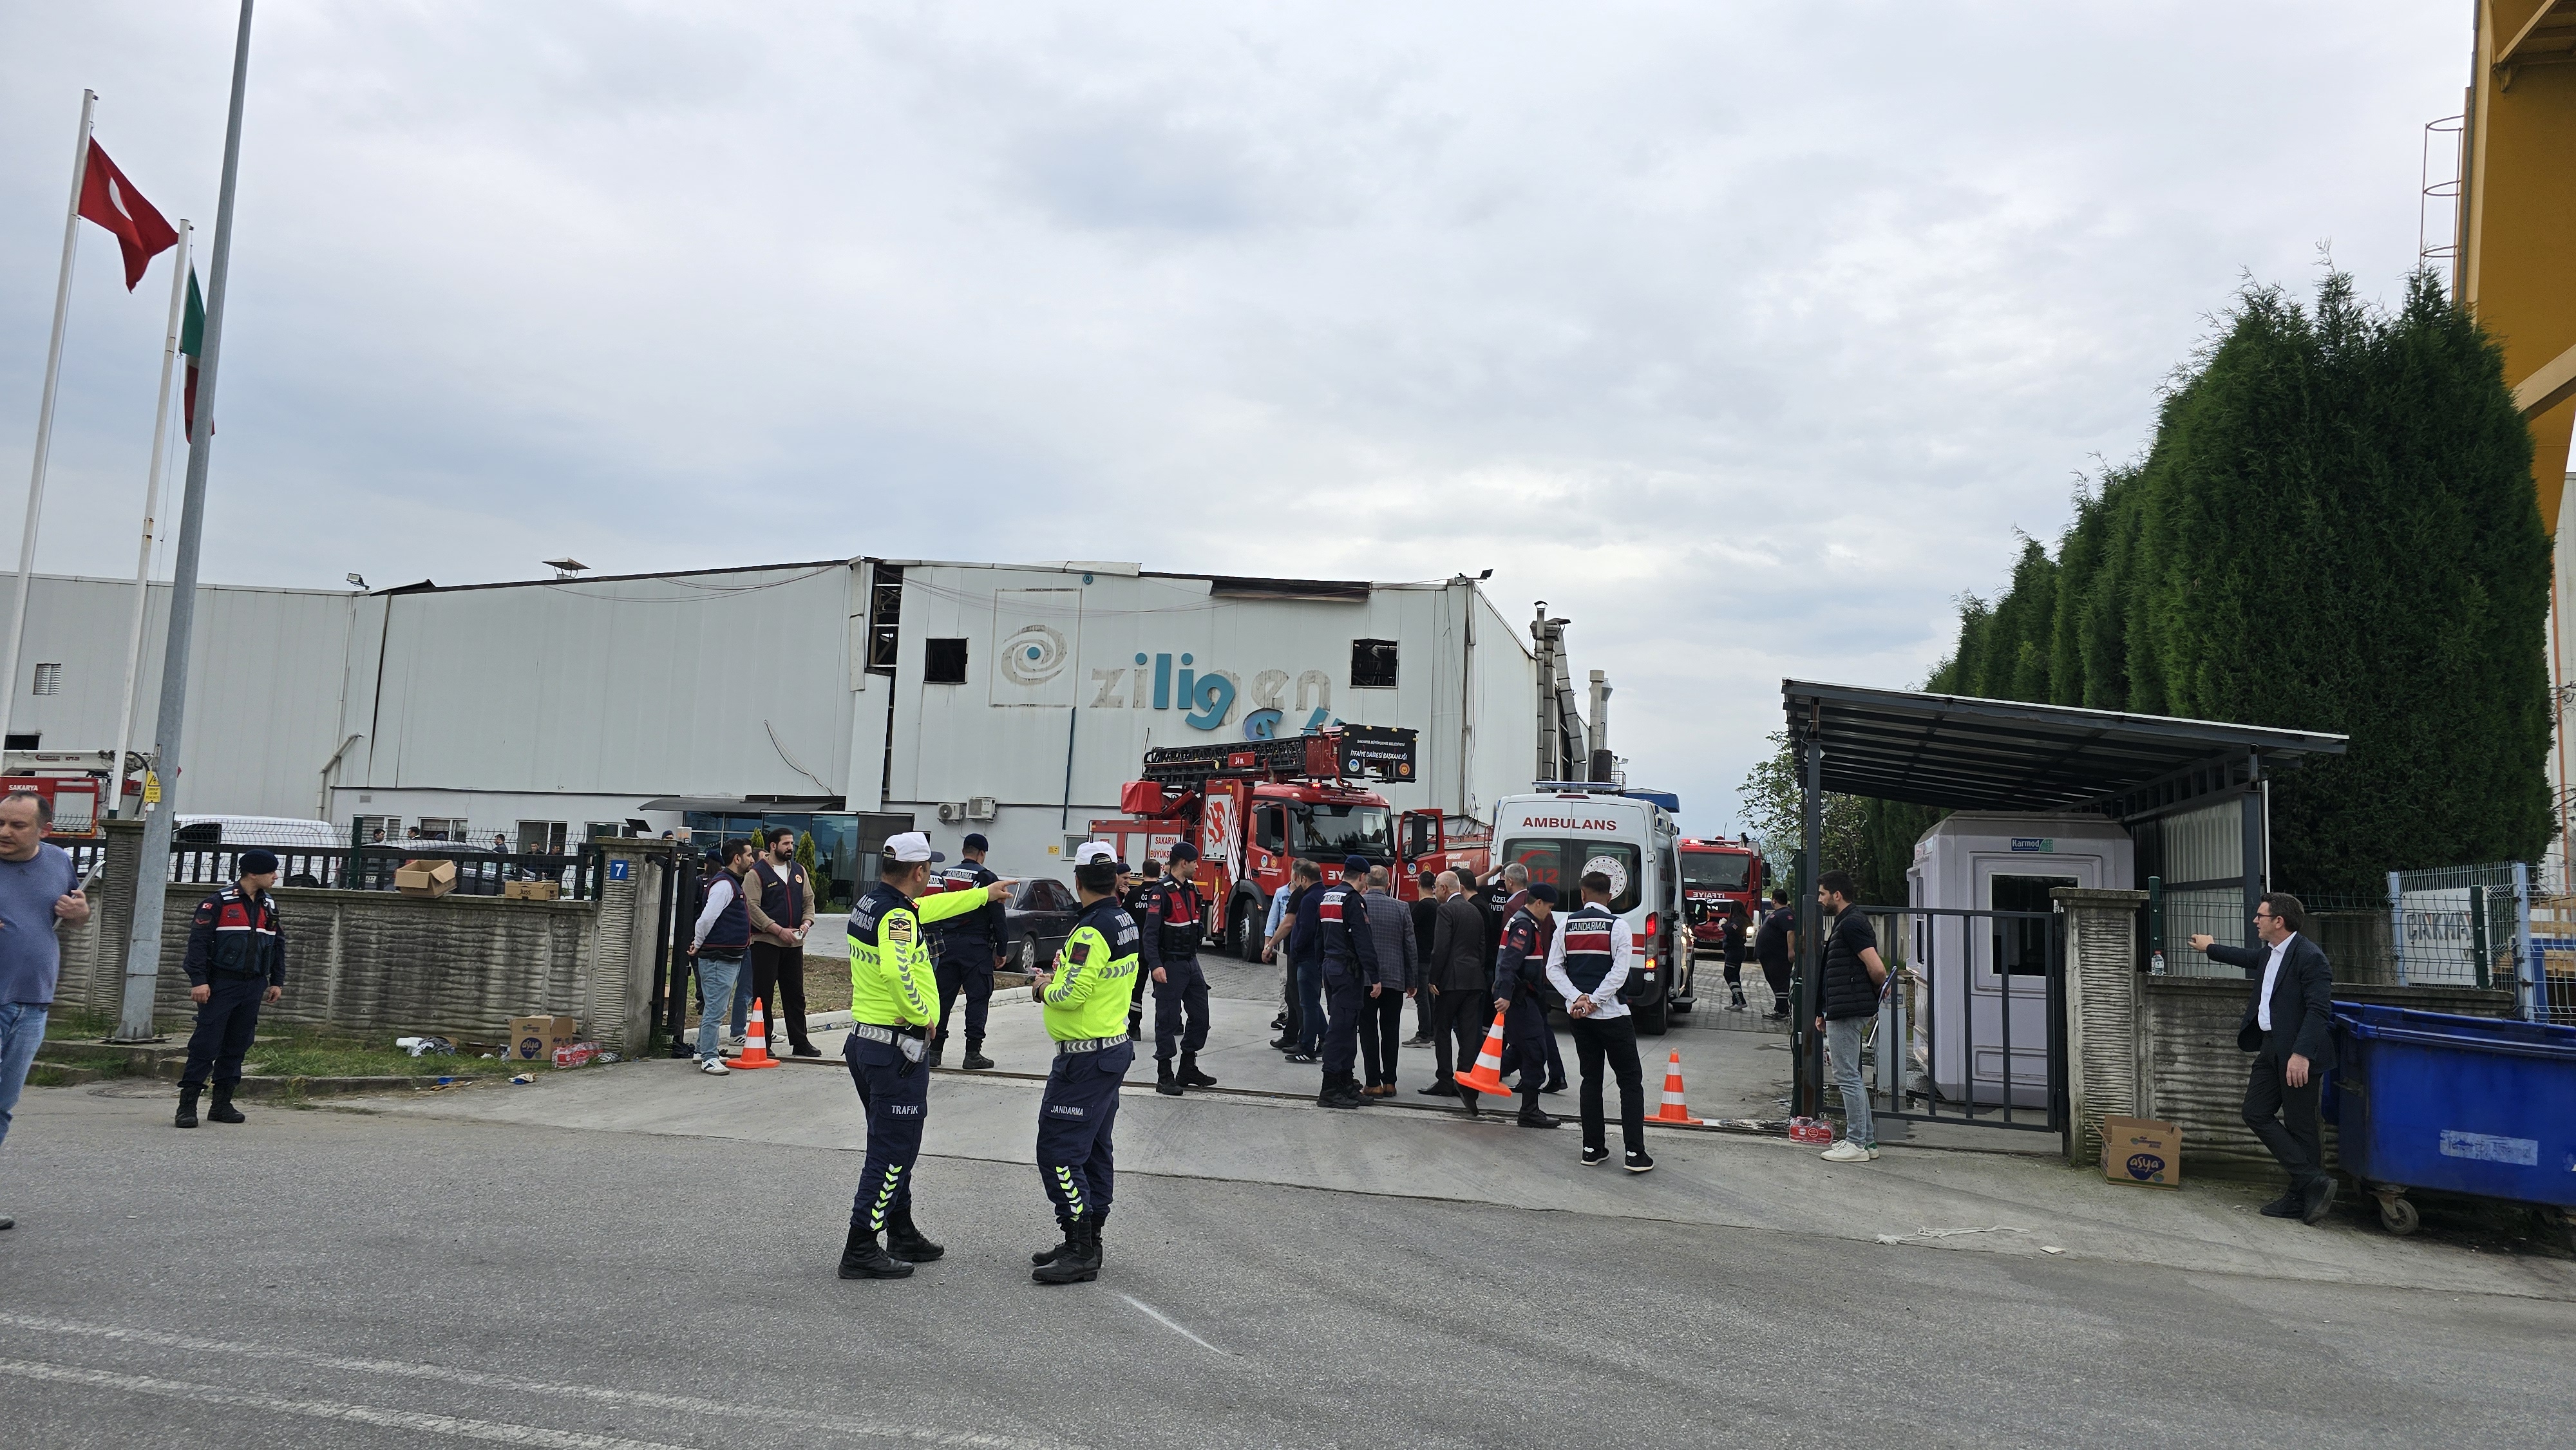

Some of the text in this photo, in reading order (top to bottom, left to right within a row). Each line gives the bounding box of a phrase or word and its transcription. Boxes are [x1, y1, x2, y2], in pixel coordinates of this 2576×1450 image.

[1522, 817, 1617, 831] AMBULANS
[1155, 836, 1177, 845] SAKARYA
[2012, 839, 2040, 847] Karmod
[615, 863, 624, 877] 7
[1492, 894, 1507, 903] ÖZEL
[1569, 921, 1607, 932] JANDARMA
[522, 1039, 540, 1052] asya
[891, 1105, 918, 1115] TRAFİK
[1050, 1105, 1084, 1116] JANDARMA
[2130, 1156, 2159, 1173] asya
